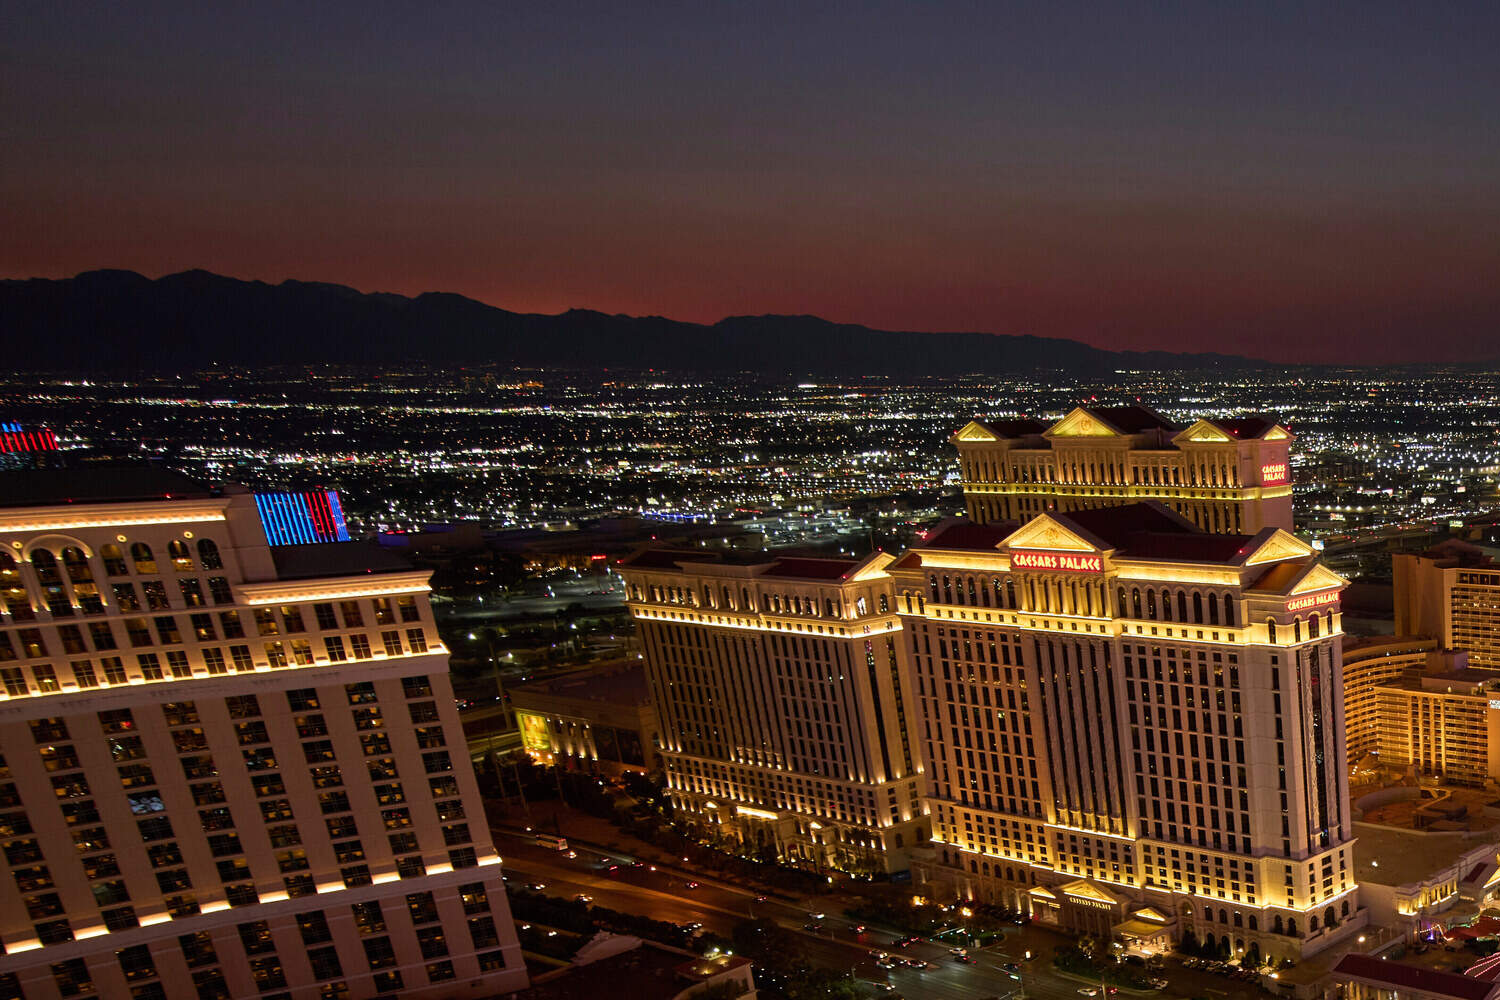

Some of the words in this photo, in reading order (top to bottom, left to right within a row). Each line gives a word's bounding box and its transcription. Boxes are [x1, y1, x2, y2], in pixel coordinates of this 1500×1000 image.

[1262, 464, 1285, 473] CAESARS
[1013, 554, 1057, 569] CAESARS
[1060, 556, 1100, 571] PALACE
[1288, 597, 1315, 610] CAESARS
[1316, 592, 1338, 604] PALACE
